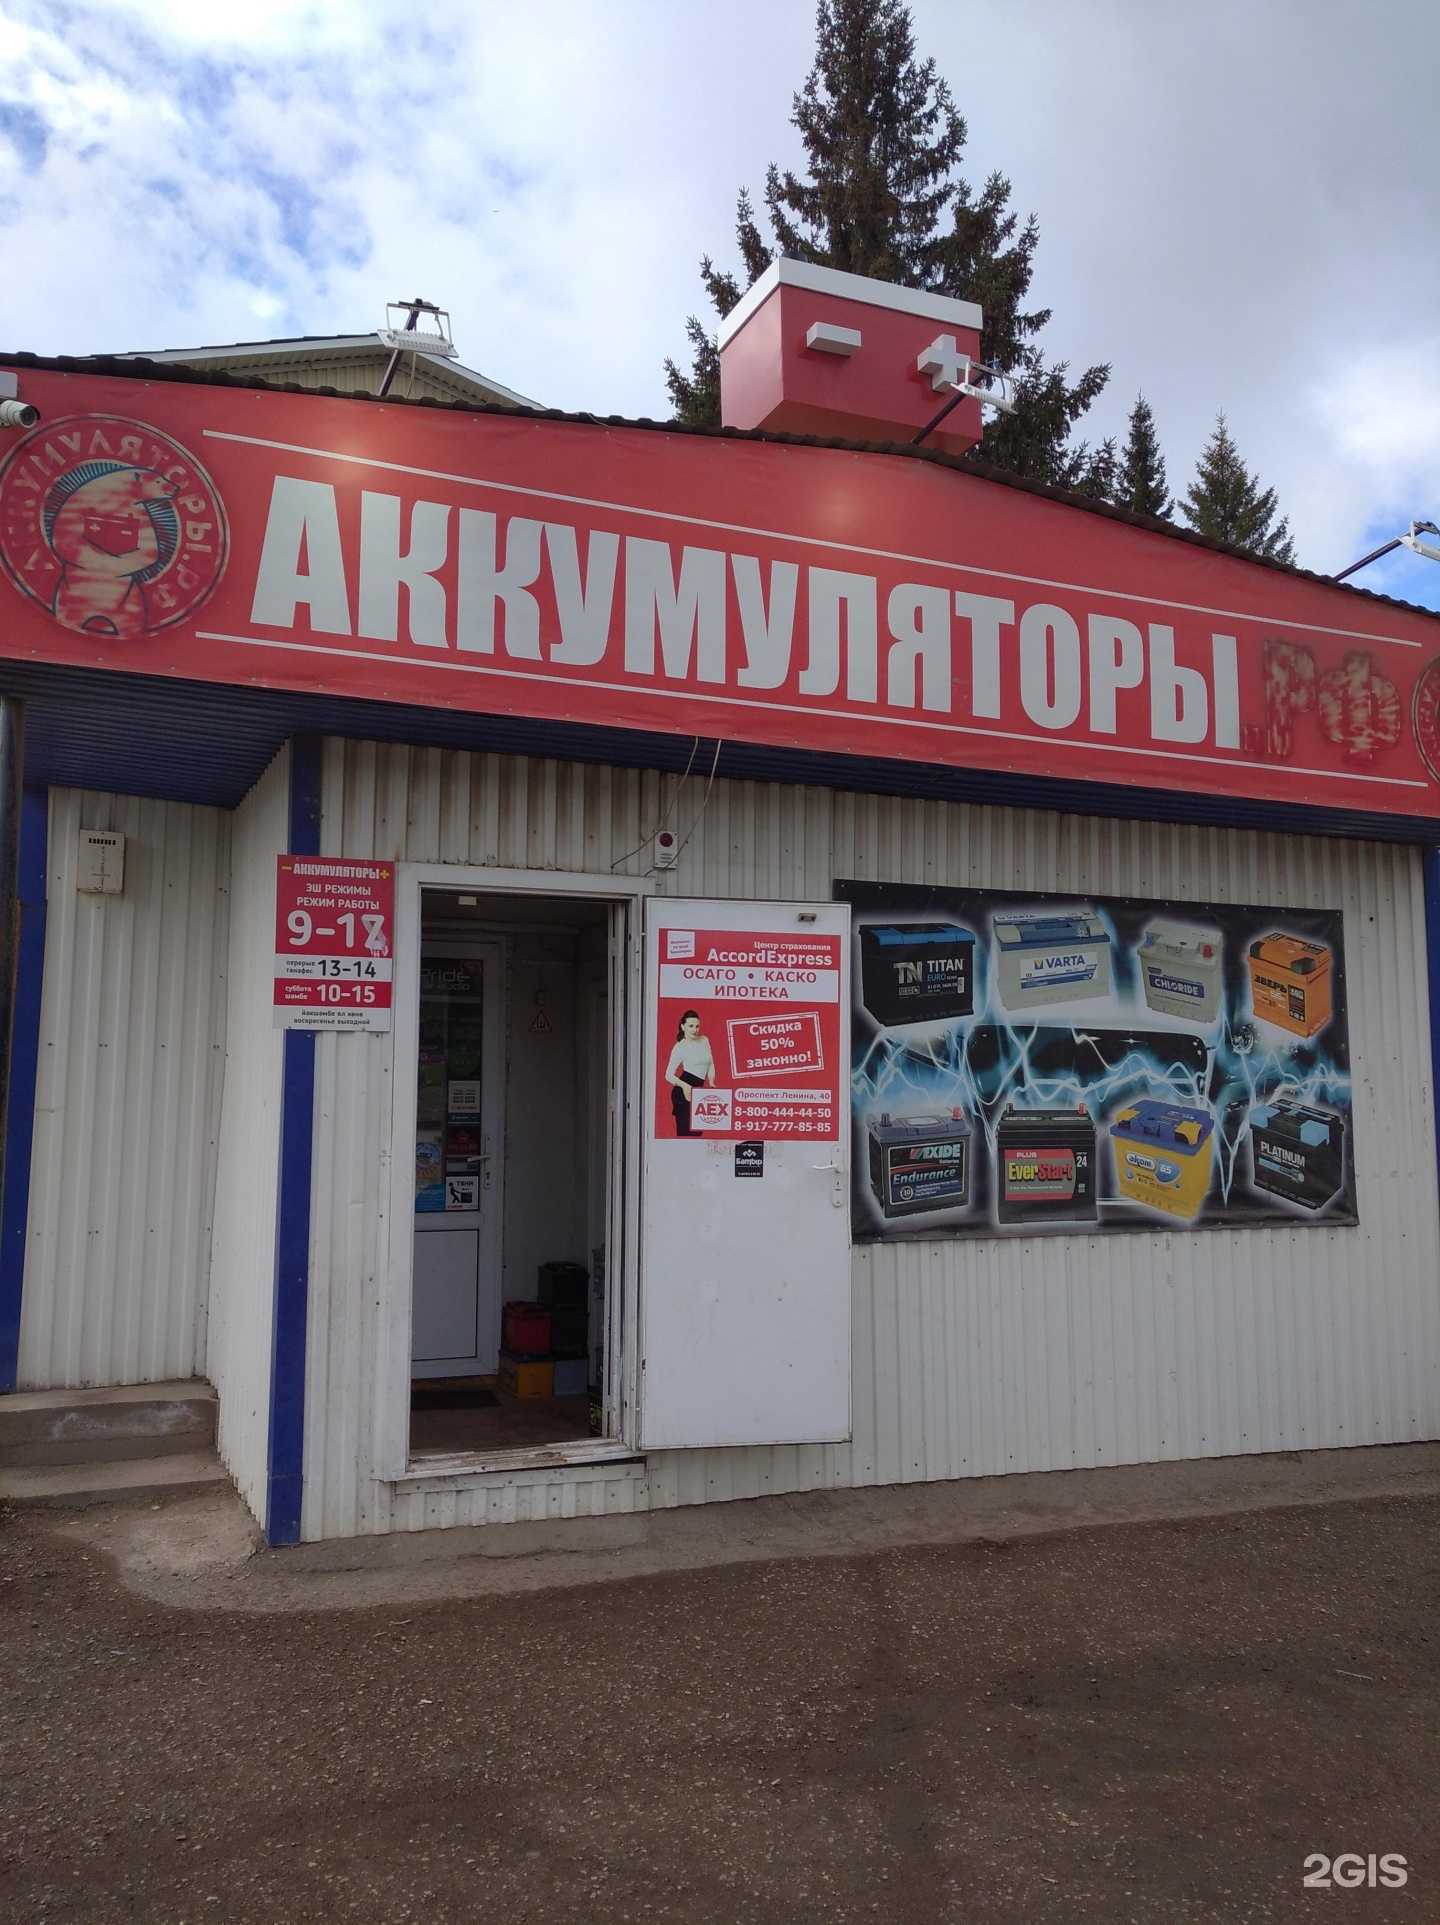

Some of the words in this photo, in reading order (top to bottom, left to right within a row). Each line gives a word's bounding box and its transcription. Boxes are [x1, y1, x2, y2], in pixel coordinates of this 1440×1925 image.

[293, 863, 380, 880] АККУМУЛЯТОРЫ
[325, 884, 371, 896] РЕЖИМЫ
[297, 897, 335, 908] РЕЖИМ
[338, 899, 380, 910] РАБОТЫ
[707, 948, 832, 967] AccordExpress
[1045, 954, 1085, 968] VARTA
[318, 960, 376, 978] 13-14
[927, 958, 964, 973] TITAN
[683, 968, 736, 981] ОСАГО
[765, 971, 817, 983] КАСКО
[316, 984, 376, 1003] 10-15
[714, 986, 789, 998] ИПОТЕКА
[1154, 977, 1199, 996] CHLORIDE
[749, 1020, 802, 1036] Скидка
[760, 1036, 794, 1051] 50%
[746, 1051, 812, 1068] законно!
[738, 1090, 778, 1100] Проспект
[694, 1103, 729, 1116] AEX
[735, 1107, 832, 1118] 8-800-444-44-50
[735, 1121, 831, 1132] 8-917-777-85-85
[1076, 1155, 1088, 1168] 24
[1260, 1141, 1306, 1168] PLATINUM
[893, 1167, 956, 1184] Endurance
